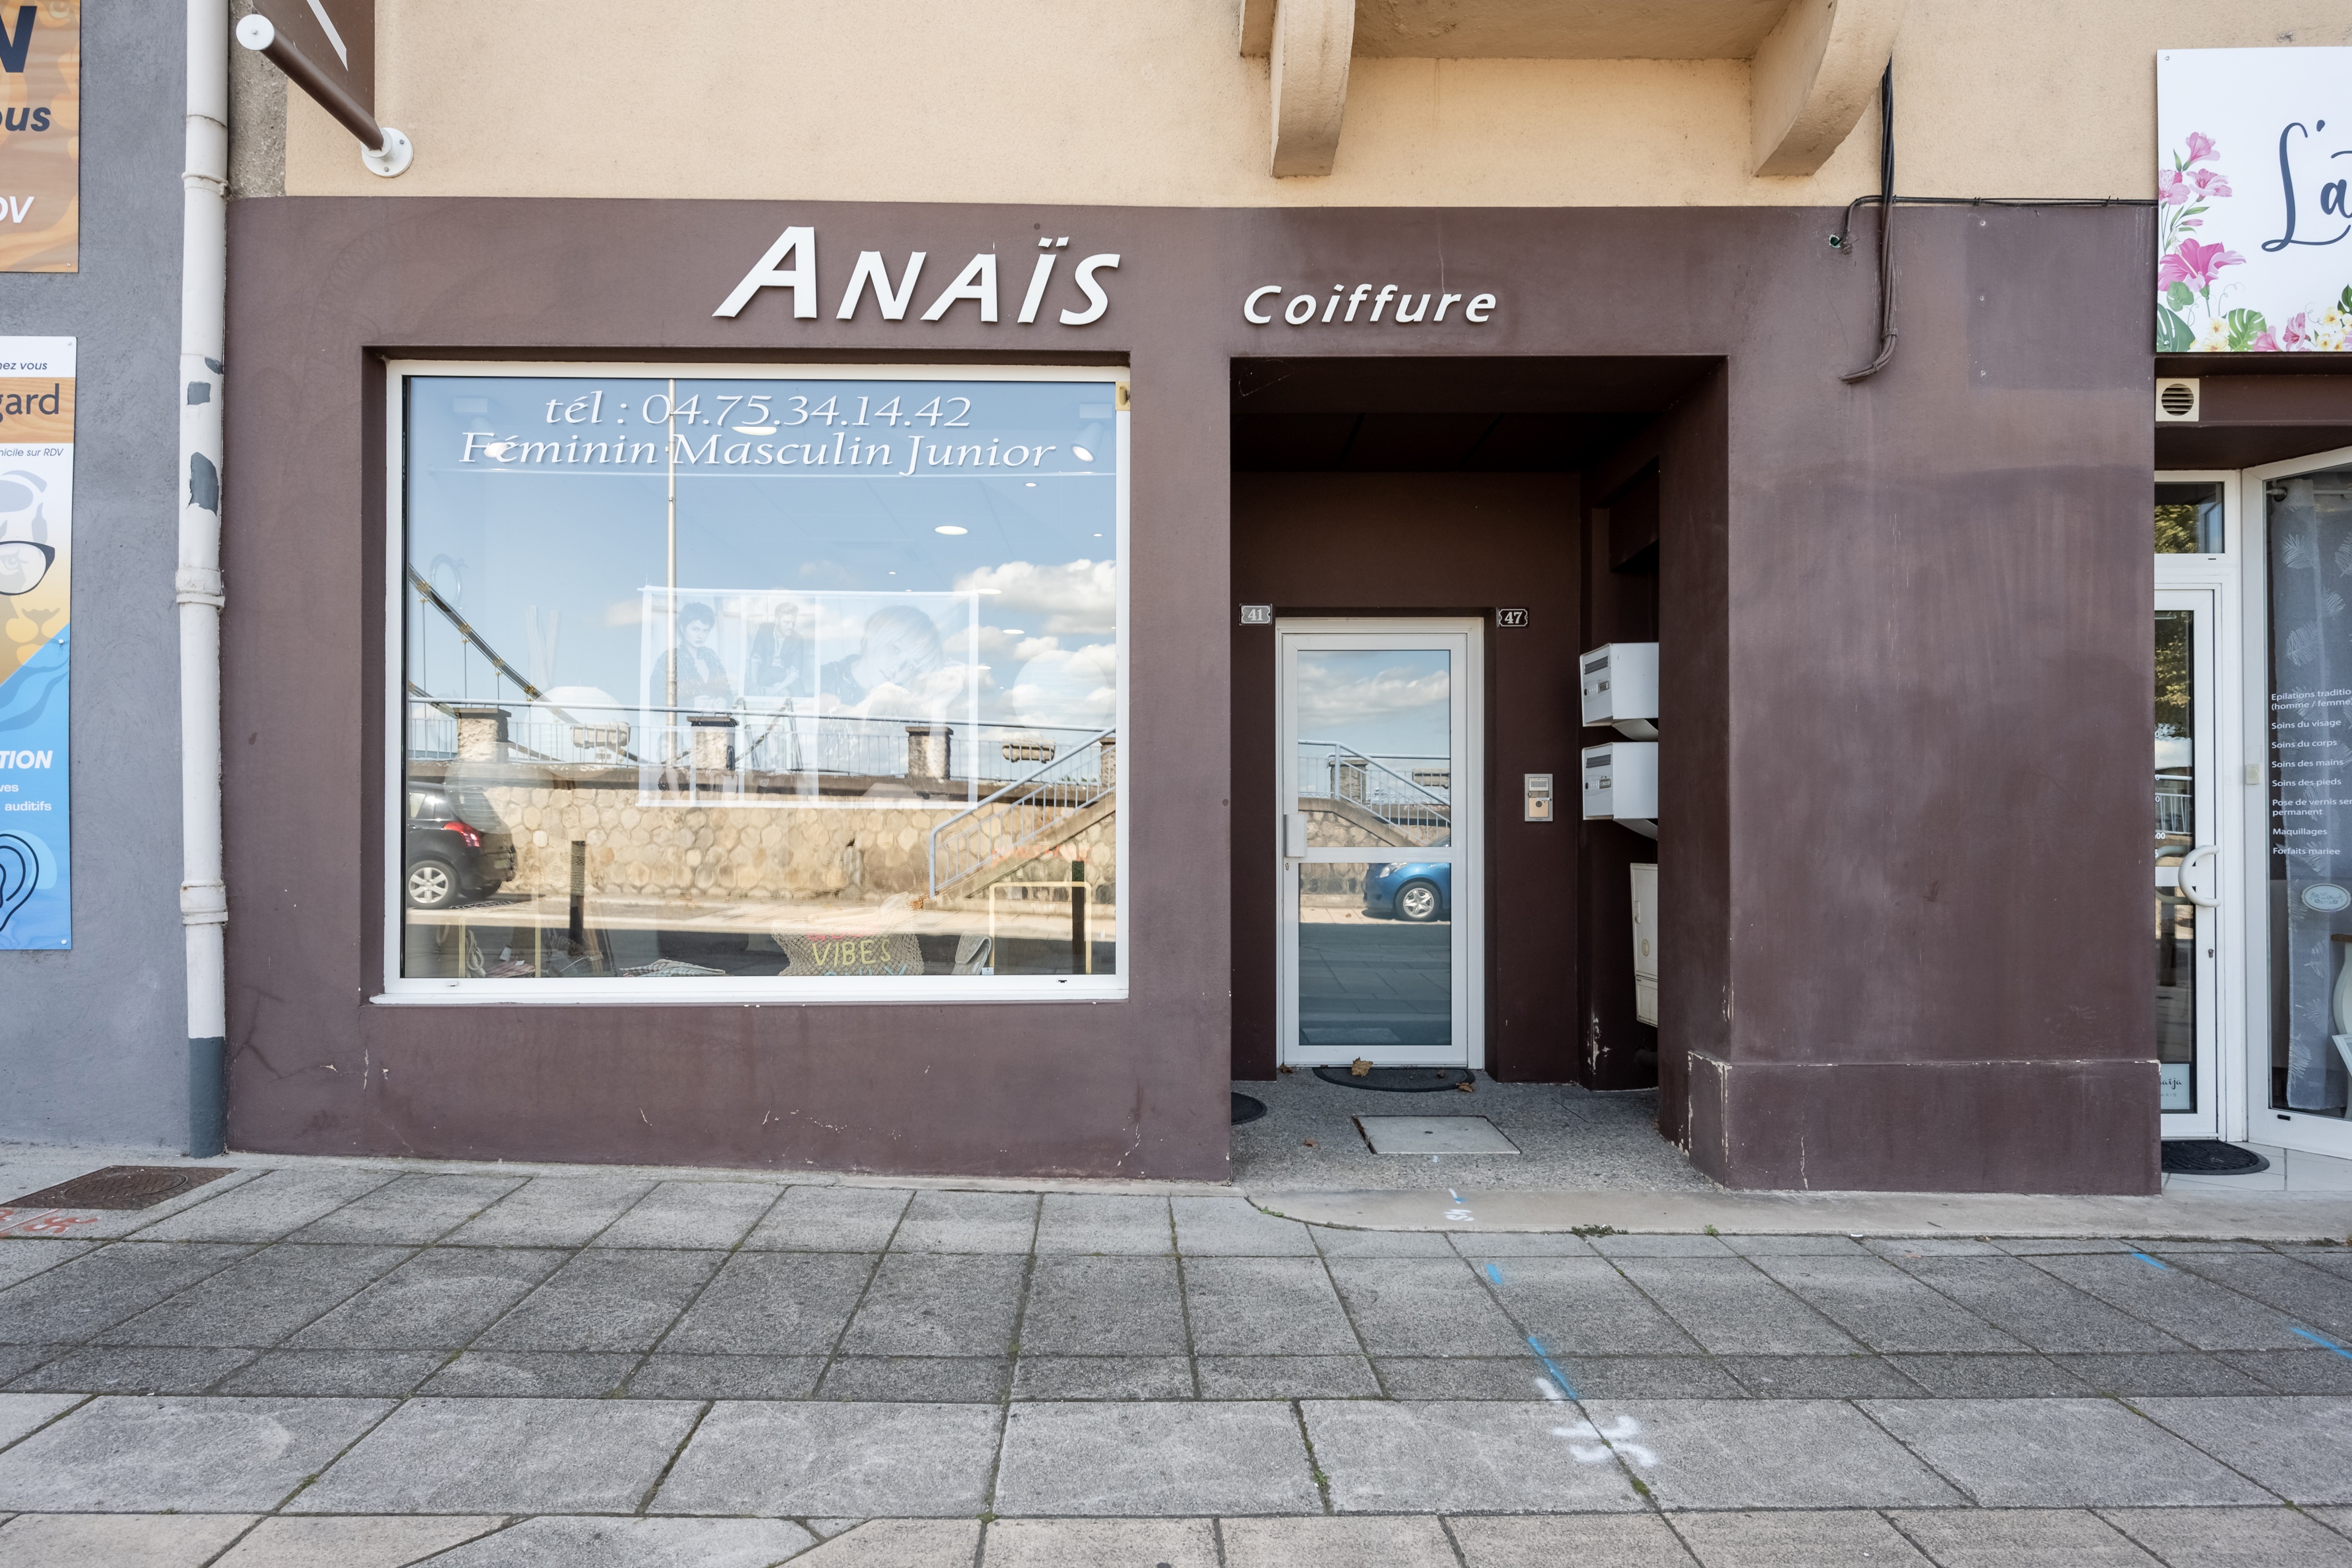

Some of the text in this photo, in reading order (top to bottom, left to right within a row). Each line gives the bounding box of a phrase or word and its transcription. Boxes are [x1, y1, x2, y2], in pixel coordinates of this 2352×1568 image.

[0, 107, 51, 132] us
[2261, 120, 2352, 252] L'a
[1244, 283, 1496, 325] Coiffure
[0, 383, 59, 423] ard
[546, 391, 603, 424] tél
[642, 394, 970, 426] 04.75.34.14.42
[43, 448, 64, 456] RDV
[459, 431, 1056, 476] Féminin Masculin Junior
[1248, 609, 1263, 621] 41
[1505, 611, 1523, 624] 47
[2271, 688, 2352, 701] Epilations traditio
[2271, 701, 2309, 711] (homme
[2316, 778, 2342, 787] pieds
[5, 801, 52, 811] auditifs
[2272, 808, 2323, 817] permanent
[2273, 828, 2328, 836] Maquillages
[812, 939, 891, 967] VIBES
[2161, 1077, 2183, 1090] aïja
